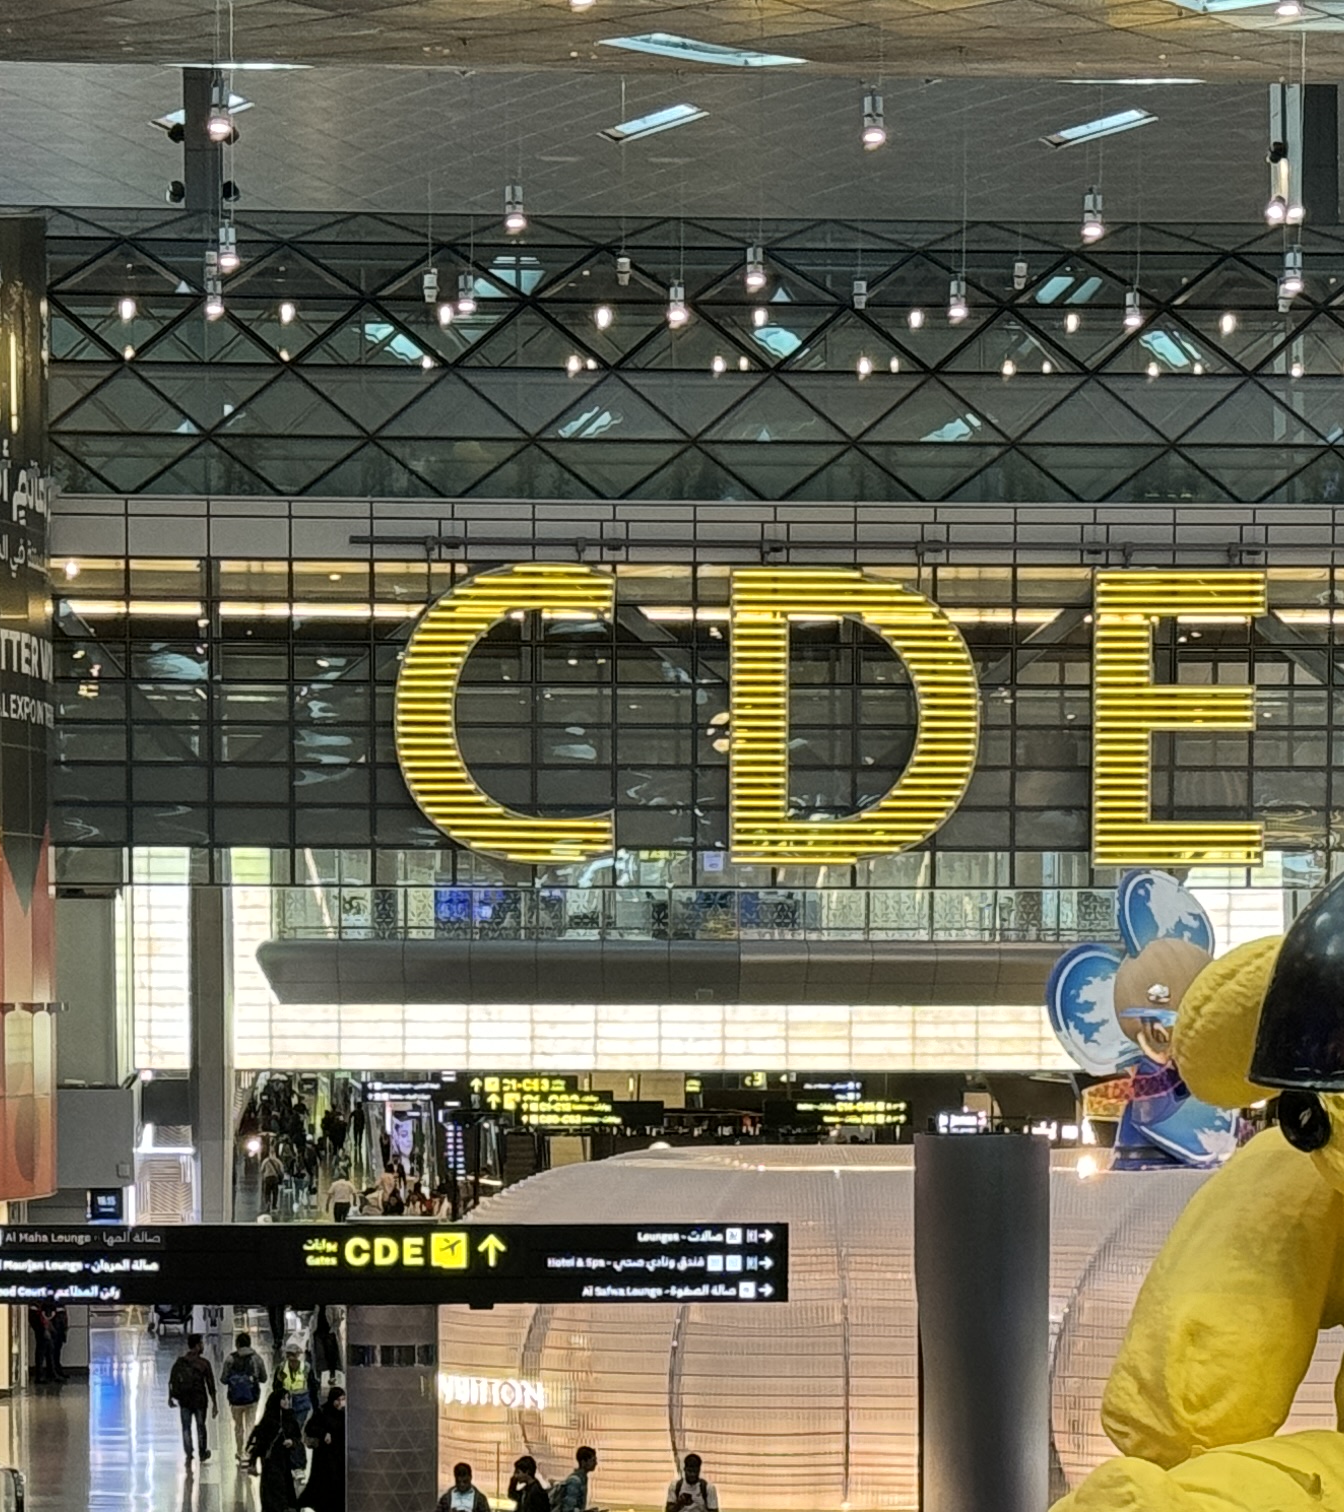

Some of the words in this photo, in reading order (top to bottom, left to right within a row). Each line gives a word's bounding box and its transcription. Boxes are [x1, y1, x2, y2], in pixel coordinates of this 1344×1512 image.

[5, 1231, 18, 1243] Al
[19, 1231, 49, 1244] Maha
[51, 1231, 92, 1246] Lounge
[132, 1230, 161, 1244] صالة
[343, 1236, 426, 1267] CDE
[305, 1254, 339, 1267] Gates
